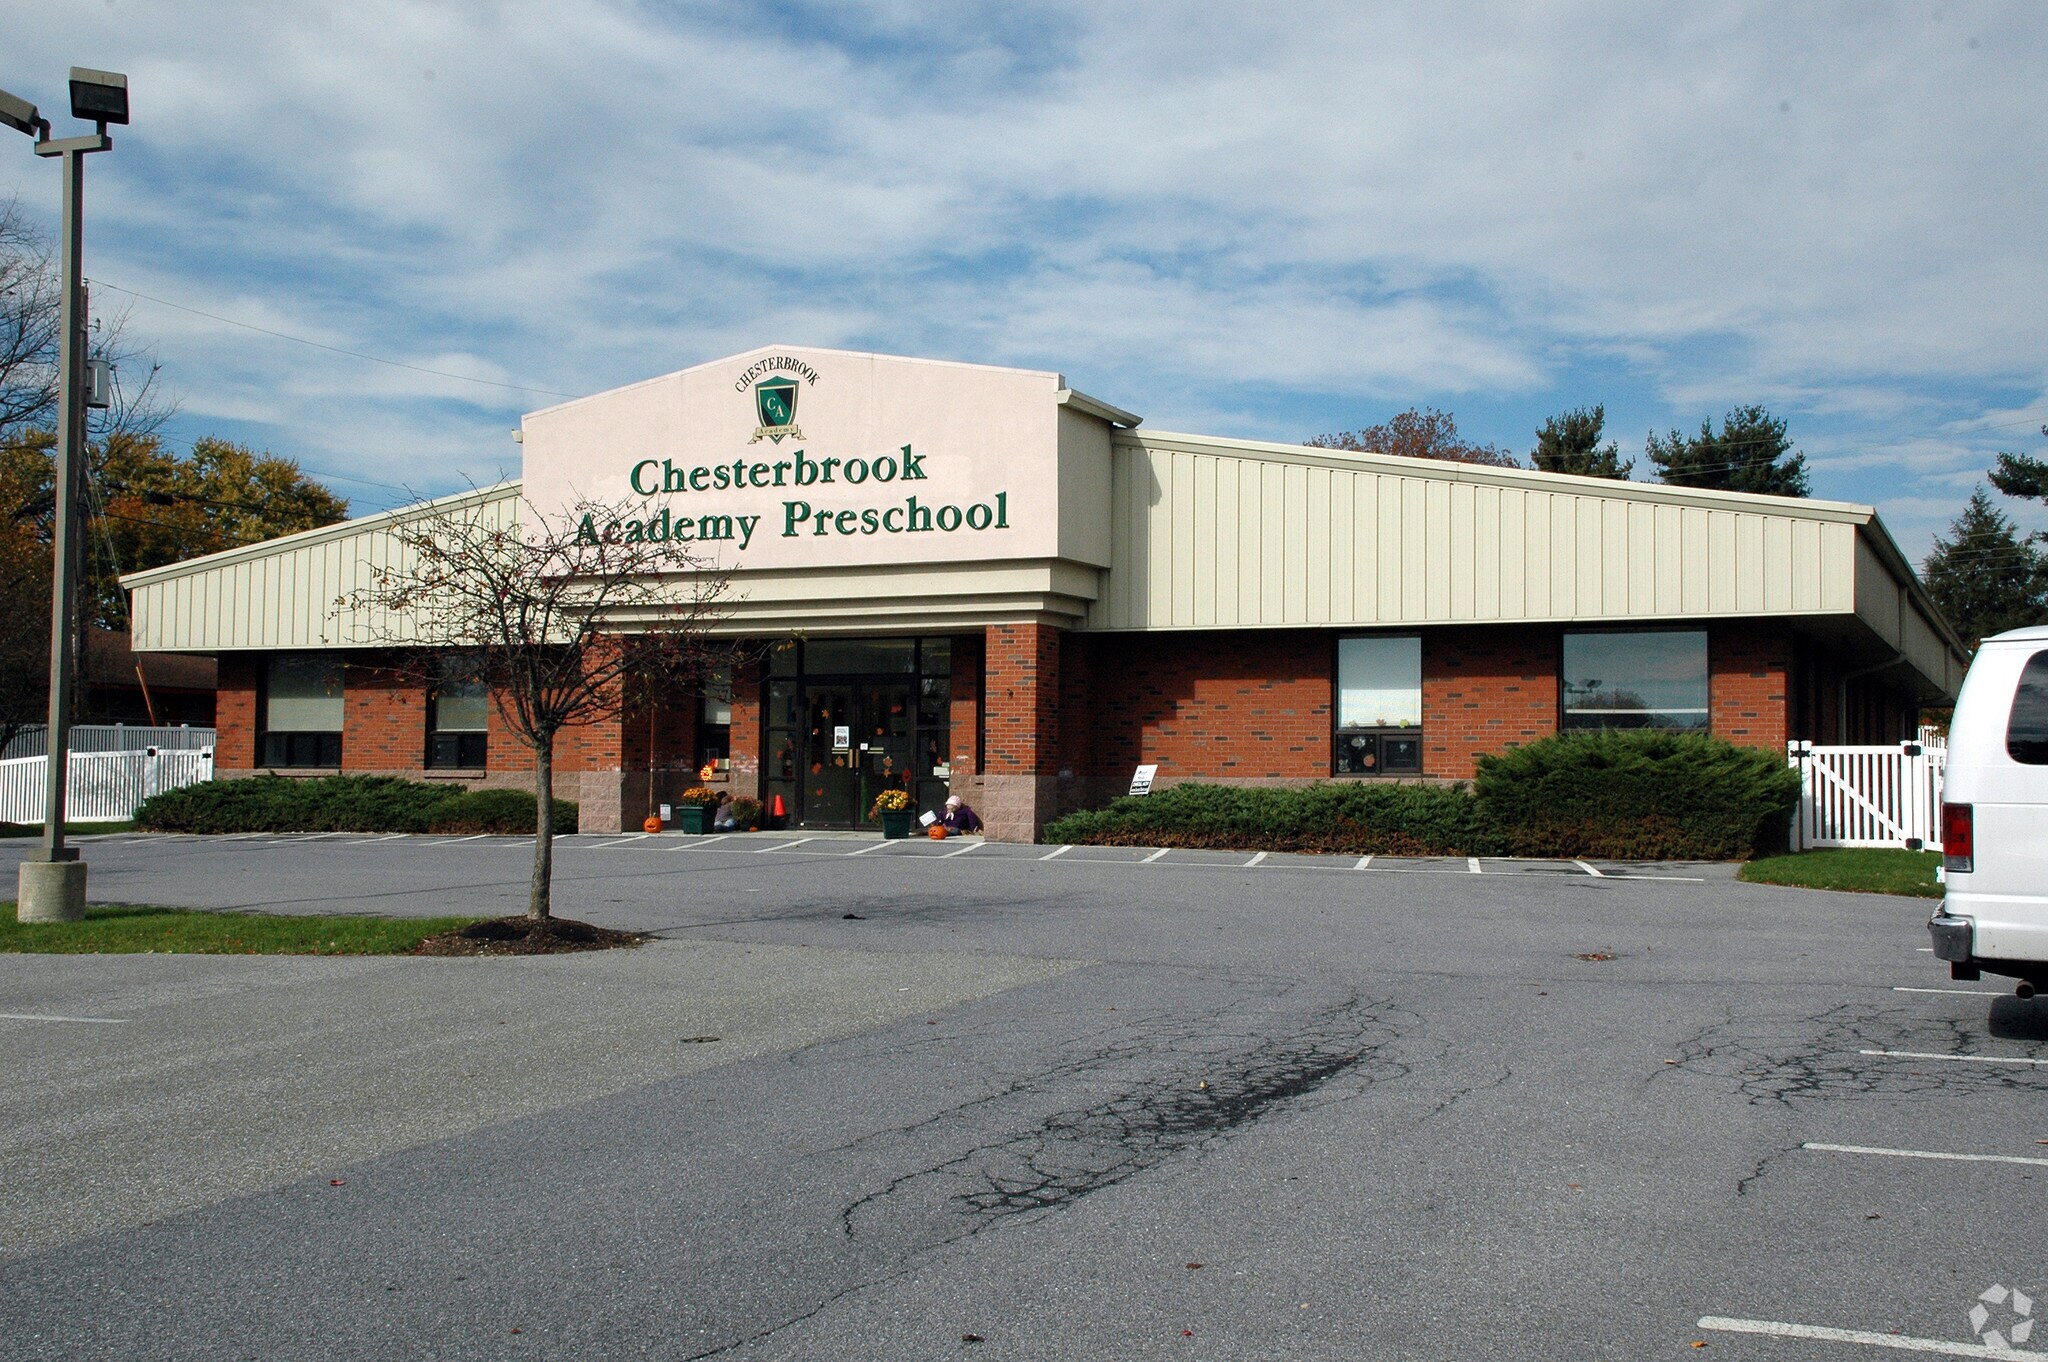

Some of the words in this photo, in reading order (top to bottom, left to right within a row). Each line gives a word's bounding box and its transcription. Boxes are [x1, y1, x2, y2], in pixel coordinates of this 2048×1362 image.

[735, 356, 820, 392] CHESTERBROOK
[630, 444, 928, 495] Chesterbrook
[570, 507, 761, 551] Academy
[781, 491, 1010, 538] Preschool
